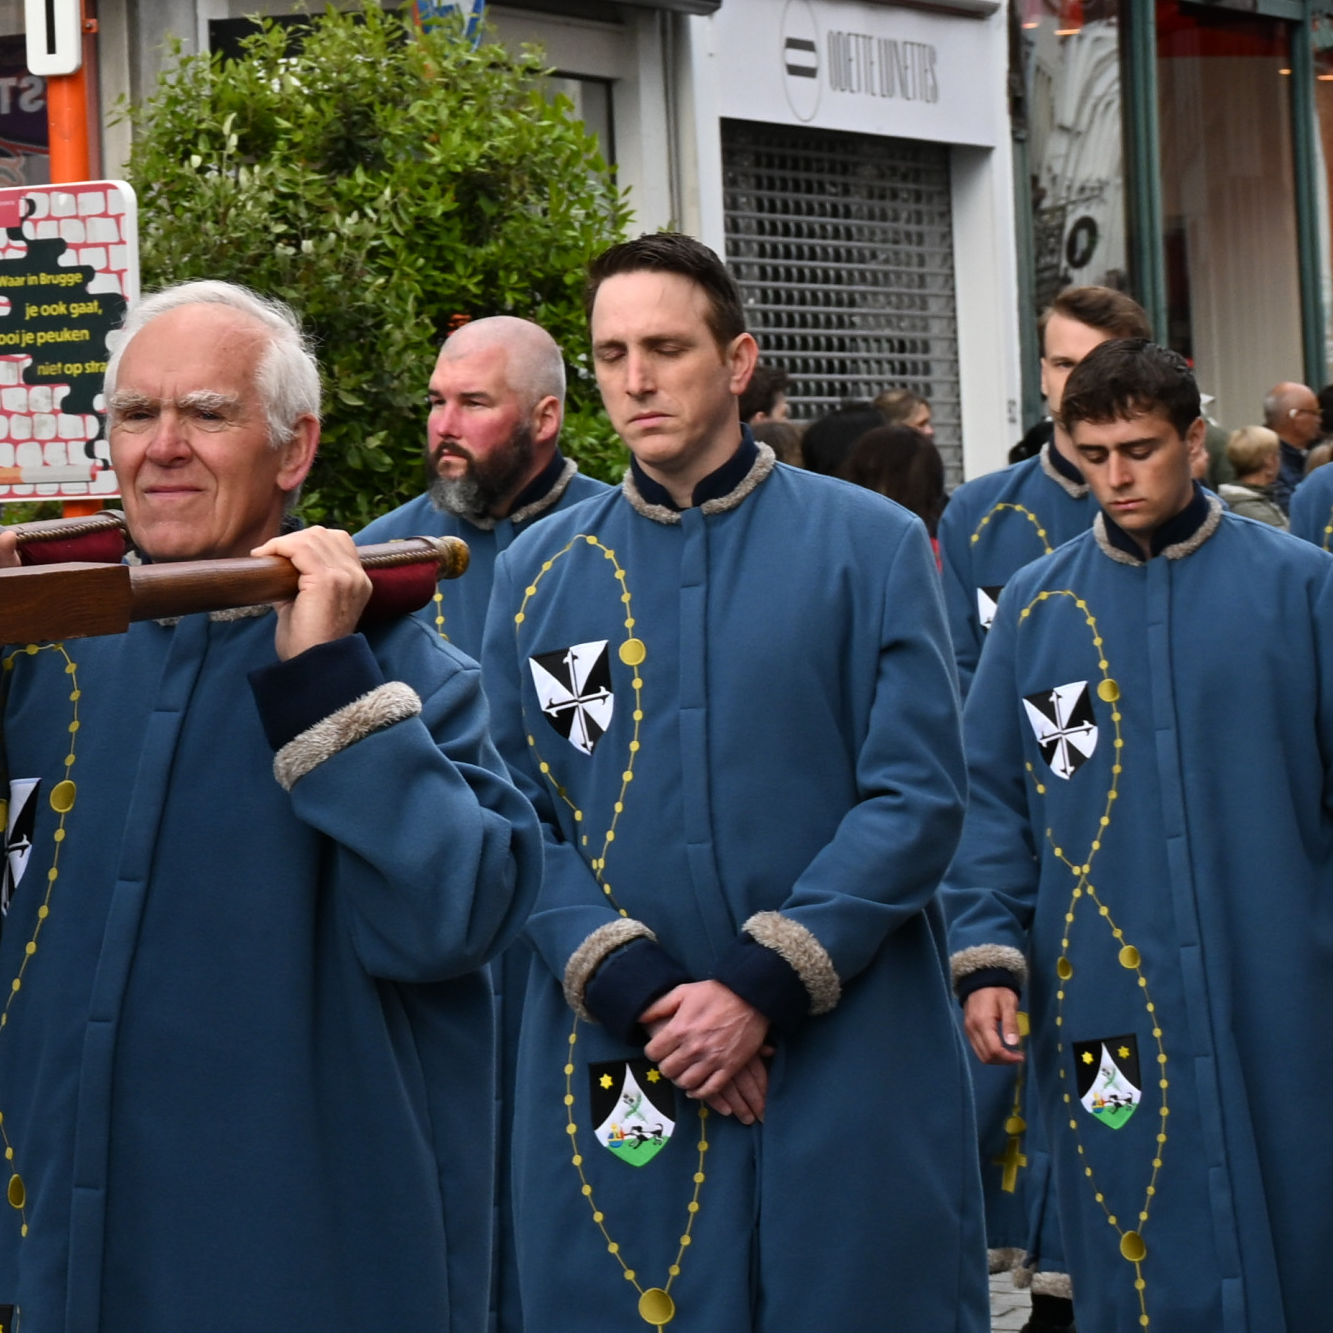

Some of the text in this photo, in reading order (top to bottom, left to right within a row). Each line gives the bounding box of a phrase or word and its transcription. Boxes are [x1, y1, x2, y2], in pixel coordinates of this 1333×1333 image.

[27, 273, 38, 286] in
[39, 272, 83, 286] Brugge
[25, 299, 103, 320] je ook gaat,
[21, 330, 35, 347] je
[36, 327, 90, 346] peuken
[37, 360, 108, 377] niet op stra
